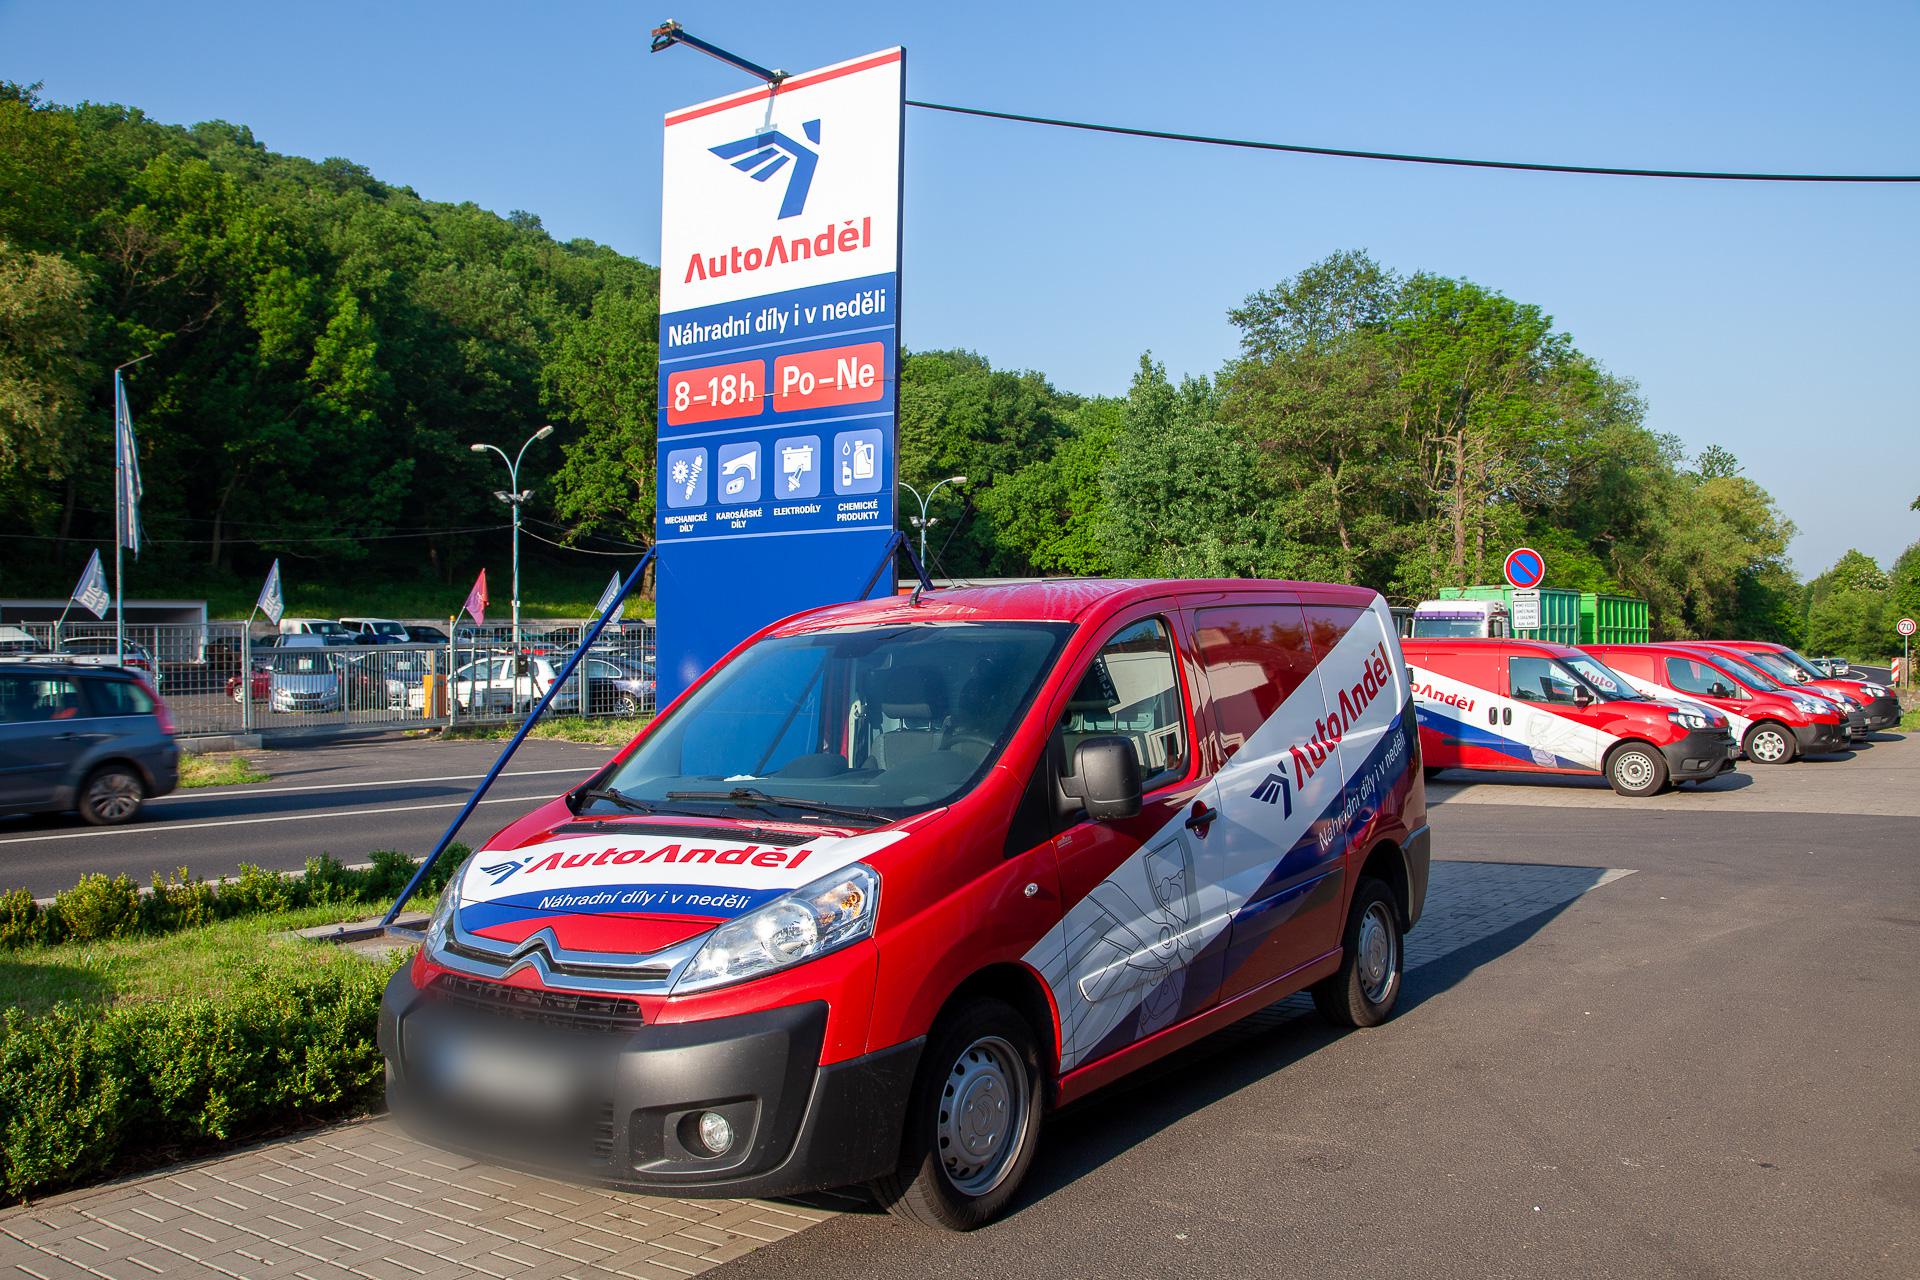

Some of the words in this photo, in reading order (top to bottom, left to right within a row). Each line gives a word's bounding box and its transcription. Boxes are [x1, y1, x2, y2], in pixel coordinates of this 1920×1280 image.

[684, 216, 871, 284] AutoAnděl
[668, 312, 750, 348] Náhradní
[755, 307, 790, 334] díly
[794, 303, 799, 325] i
[804, 307, 817, 323] v
[822, 289, 886, 321] neděli
[773, 503, 821, 516] ELEKTRODÍLY
[837, 499, 879, 511] CHEMICKÉ
[665, 511, 708, 524] MECHANICKÉ
[716, 507, 763, 520] KAROSÁŘSKÉ
[836, 511, 880, 521] PRODUKTY
[679, 523, 694, 532] DÍLY
[731, 519, 747, 529] DÍLY
[1901, 623, 1912, 631] 70
[1409, 683, 1475, 712] oAnděl
[1288, 641, 1393, 792] AutoAnděl
[1318, 788, 1361, 851] Náhradní
[1360, 773, 1376, 801] díly
[1374, 764, 1380, 781] i
[1379, 760, 1385, 775] v
[1385, 729, 1406, 768] neděli
[524, 844, 813, 874] AutoAnděl
[537, 890, 621, 910] Náhradní
[622, 889, 655, 906] díly
[659, 890, 669, 903] i
[672, 893, 685, 903] v
[686, 893, 752, 910] neděli
